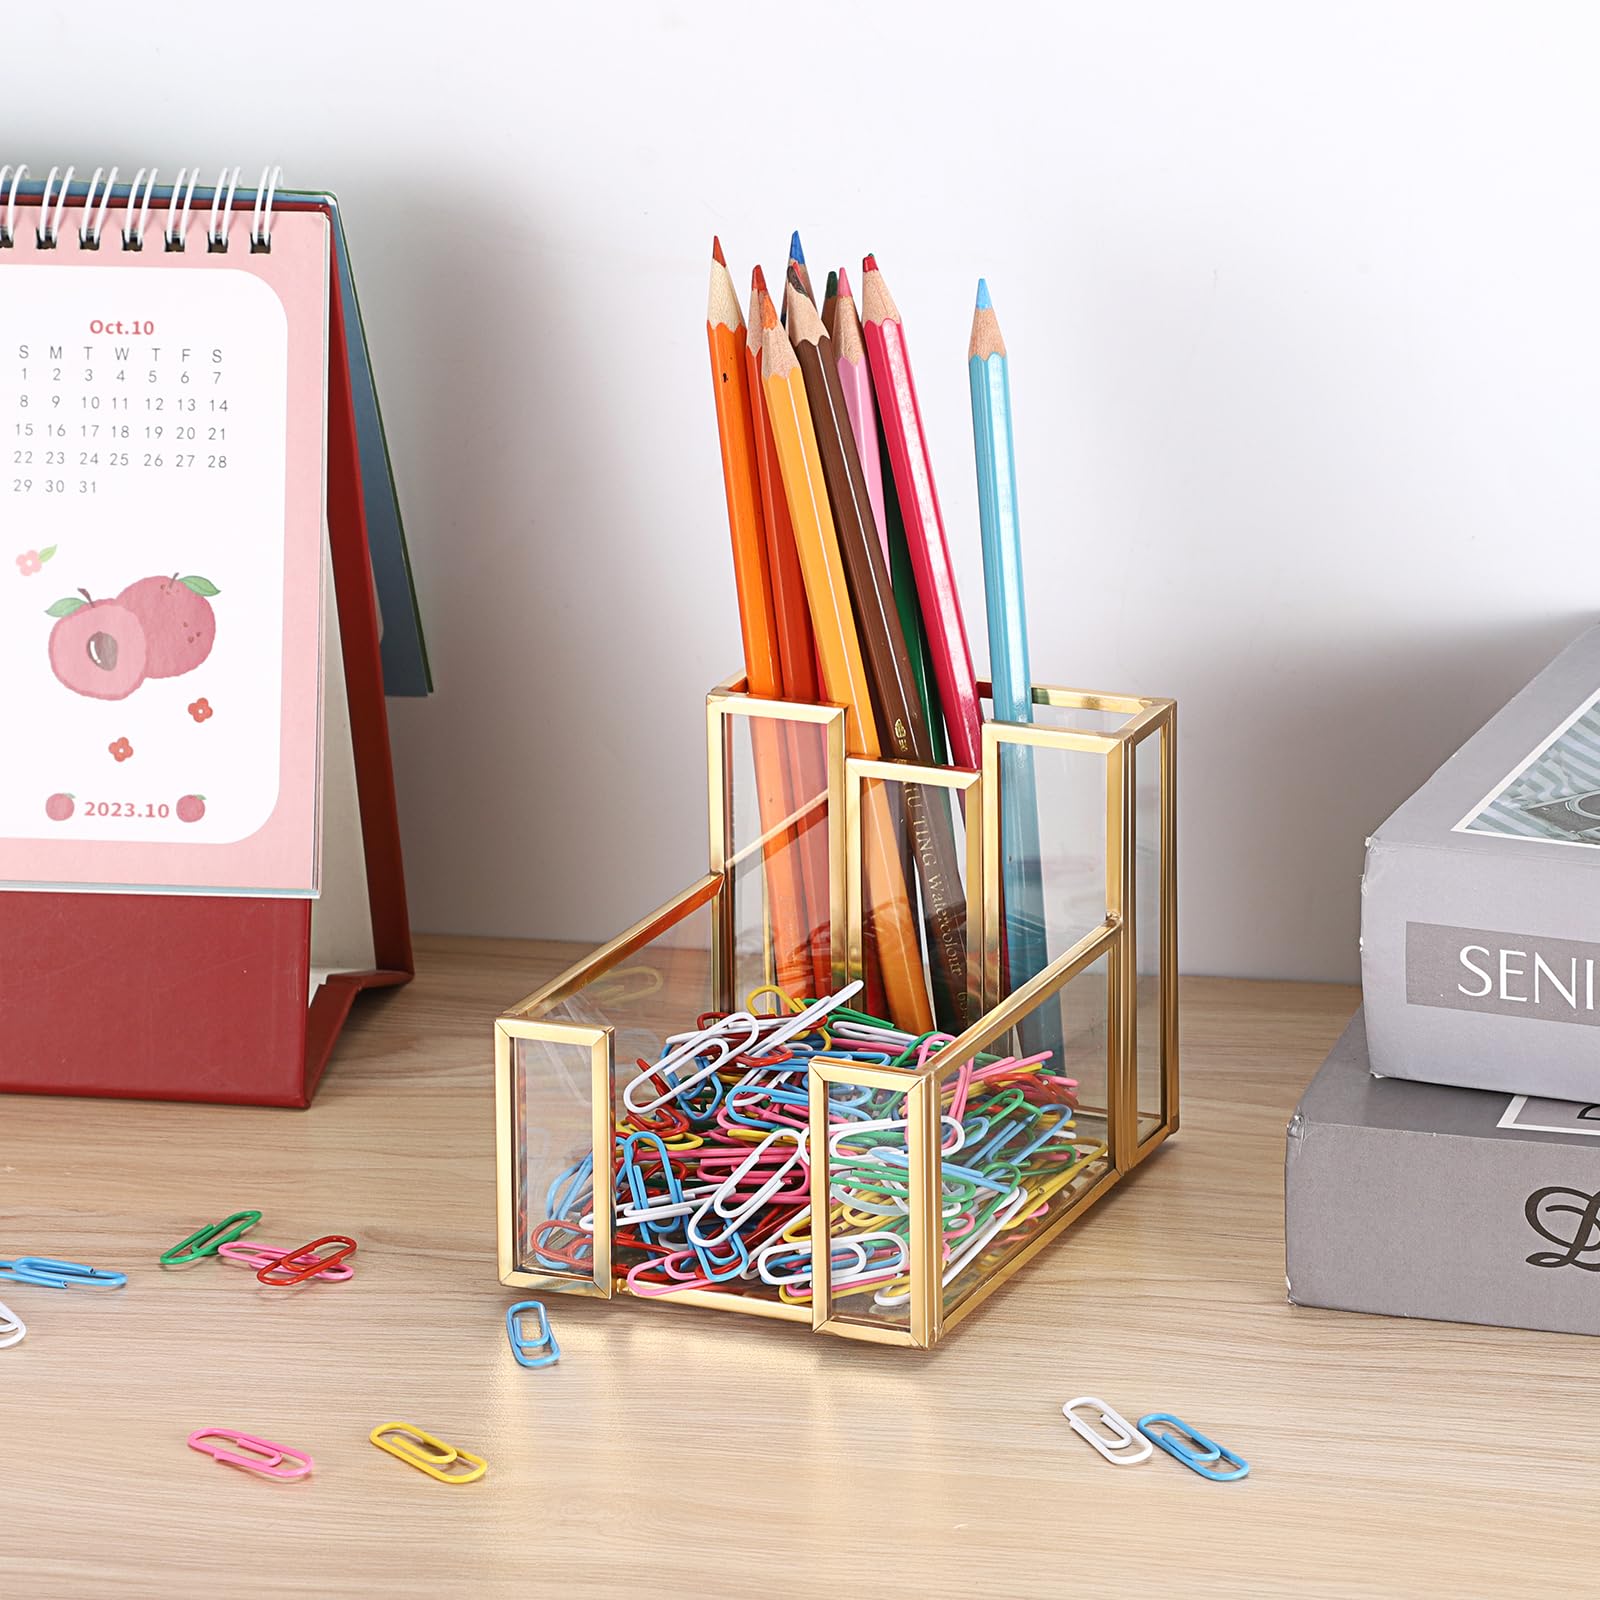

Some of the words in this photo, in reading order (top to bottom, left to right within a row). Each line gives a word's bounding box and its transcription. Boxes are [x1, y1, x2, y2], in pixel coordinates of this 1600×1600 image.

[89, 319, 155, 336] Oct.10
[18, 345, 29, 359] S
[49, 346, 63, 360] M
[83, 346, 93, 360] T
[114, 347, 130, 361] W
[151, 348, 161, 362] T
[181, 349, 191, 363] F
[211, 349, 222, 363] S
[21, 368, 27, 380] 1
[52, 368, 62, 381] 2
[84, 369, 93, 382] 3
[116, 370, 126, 382] 4
[148, 370, 158, 383] 5
[180, 371, 190, 384] 6
[212, 372, 222, 384] 7
[19, 395, 29, 408] 8
[51, 396, 61, 408] 9
[81, 396, 101, 409] 10
[111, 397, 129, 410] 11
[145, 398, 164, 411] 12
[177, 399, 196, 412] 13
[209, 400, 229, 412] 14
[15, 423, 34, 436] 15
[47, 424, 66, 437] 16
[80, 425, 100, 438] 17
[111, 425, 130, 438] 18
[145, 426, 164, 439] 19
[176, 427, 196, 440] 20
[207, 427, 226, 440] 21
[13, 451, 33, 464] 22
[45, 451, 65, 464] 23
[79, 452, 99, 465] 24
[109, 453, 129, 466] 25
[143, 454, 164, 467] 26
[175, 454, 195, 467] 27
[207, 455, 228, 468] 28
[13, 479, 33, 492] 29
[45, 480, 65, 493] 30
[79, 481, 97, 494] 31
[84, 801, 170, 818] 2023.10
[913, 815, 937, 866] TING
[1457, 945, 1595, 1011] SENI
